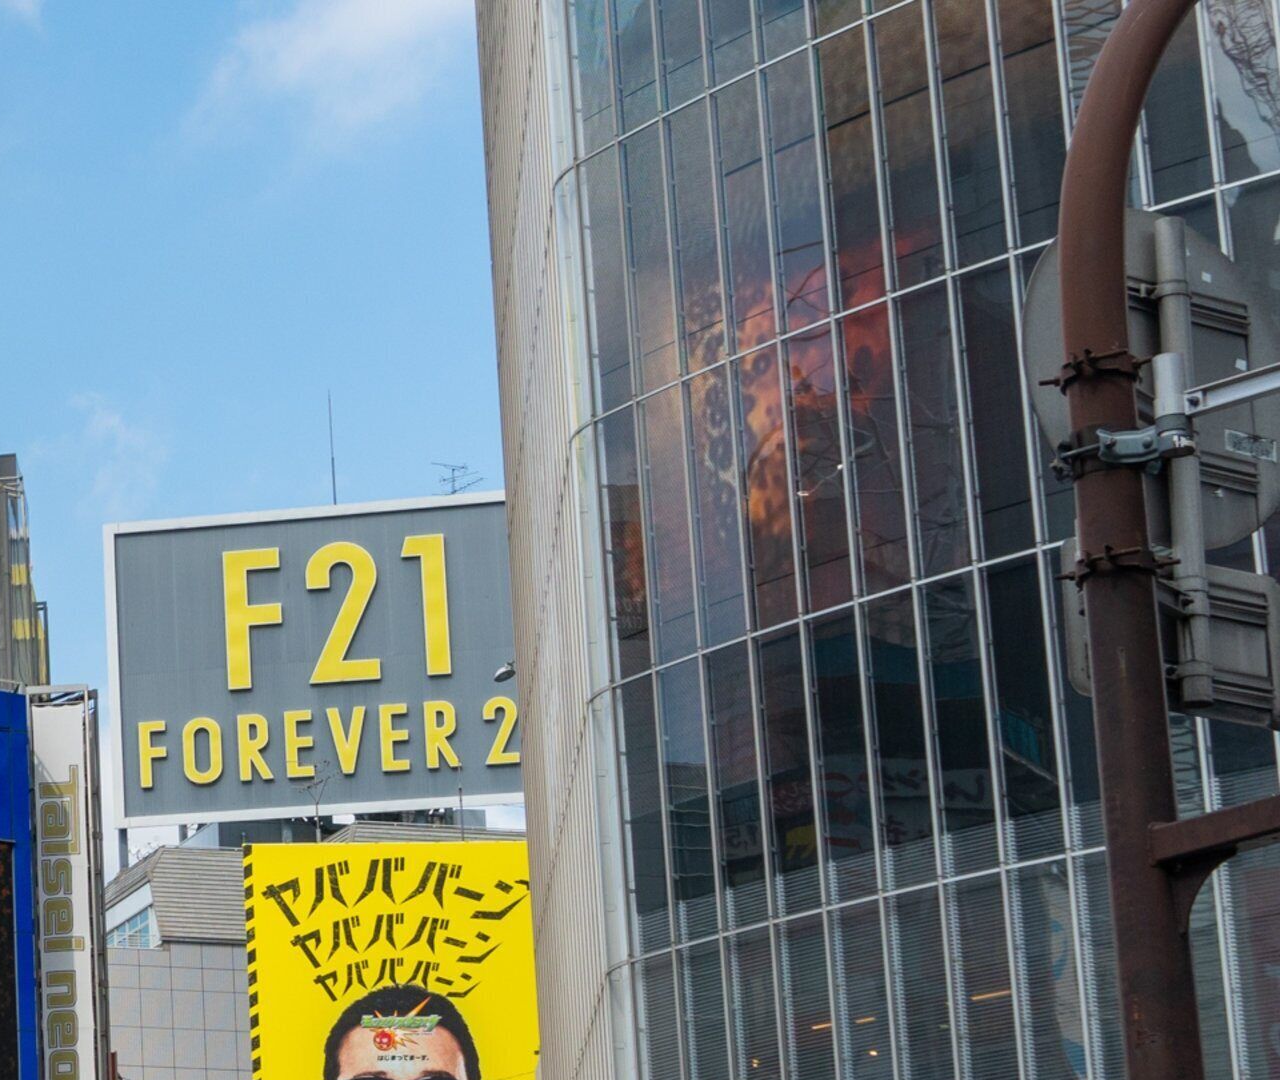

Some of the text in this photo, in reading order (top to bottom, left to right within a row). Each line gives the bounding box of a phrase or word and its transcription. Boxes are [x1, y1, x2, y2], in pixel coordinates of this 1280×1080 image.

[222, 533, 452, 692] F21
[137, 700, 462, 790] FOREVER
[260, 856, 530, 928] ヤバババーン
[289, 912, 504, 970] ヤバババーン
[313, 956, 482, 1002] ヤバババーン
